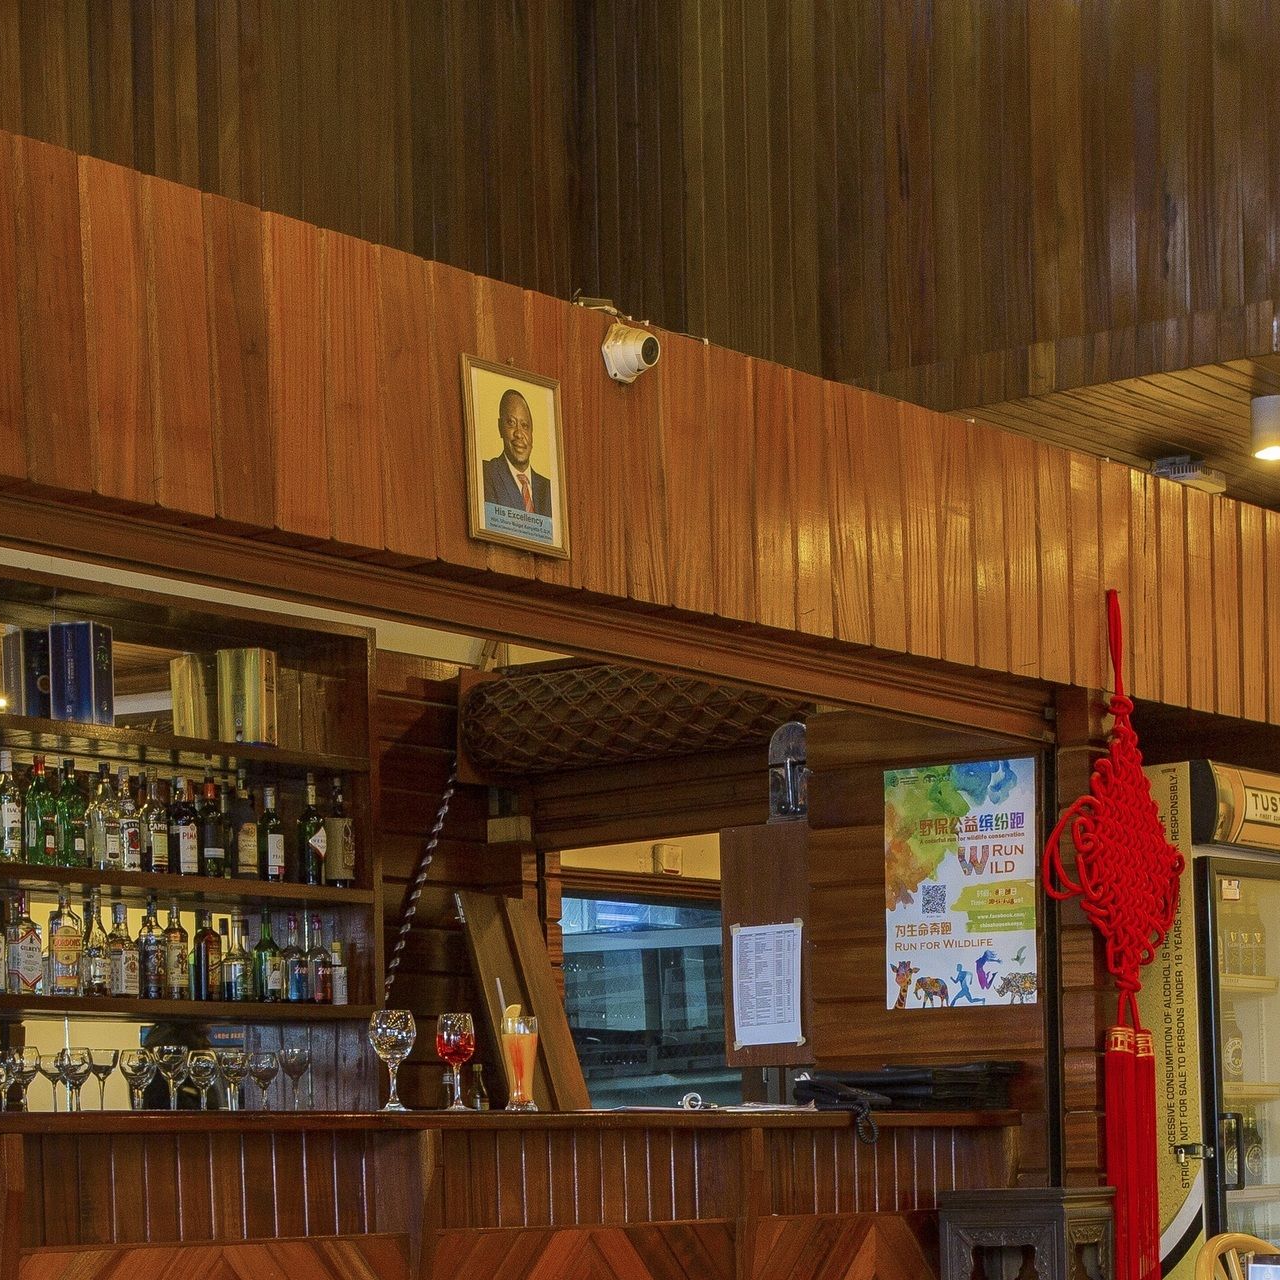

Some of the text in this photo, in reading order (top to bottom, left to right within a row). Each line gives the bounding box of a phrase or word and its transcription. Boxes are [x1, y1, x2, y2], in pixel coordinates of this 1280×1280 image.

[494, 506, 544, 527] His Excellency
[992, 844, 1024, 857] RUN
[895, 921, 952, 937] 为生命奔跑
[943, 938, 993, 949] WILDLIFE
[1161, 952, 1171, 961] IS
[1174, 954, 1183, 967] 18
[1162, 964, 1172, 1009] ALCOHOL
[1175, 970, 1185, 1005] UNDER
[1163, 1011, 1173, 1024] OF
[1176, 1007, 1186, 1054] PERSONS
[1164, 1027, 1175, 1100] CONSUMPTION
[1177, 1056, 1187, 1069] TO
[1178, 1071, 1187, 1096] SALE
[1178, 1099, 1188, 1118] FOR
[1179, 1119, 1189, 1141] NOT
